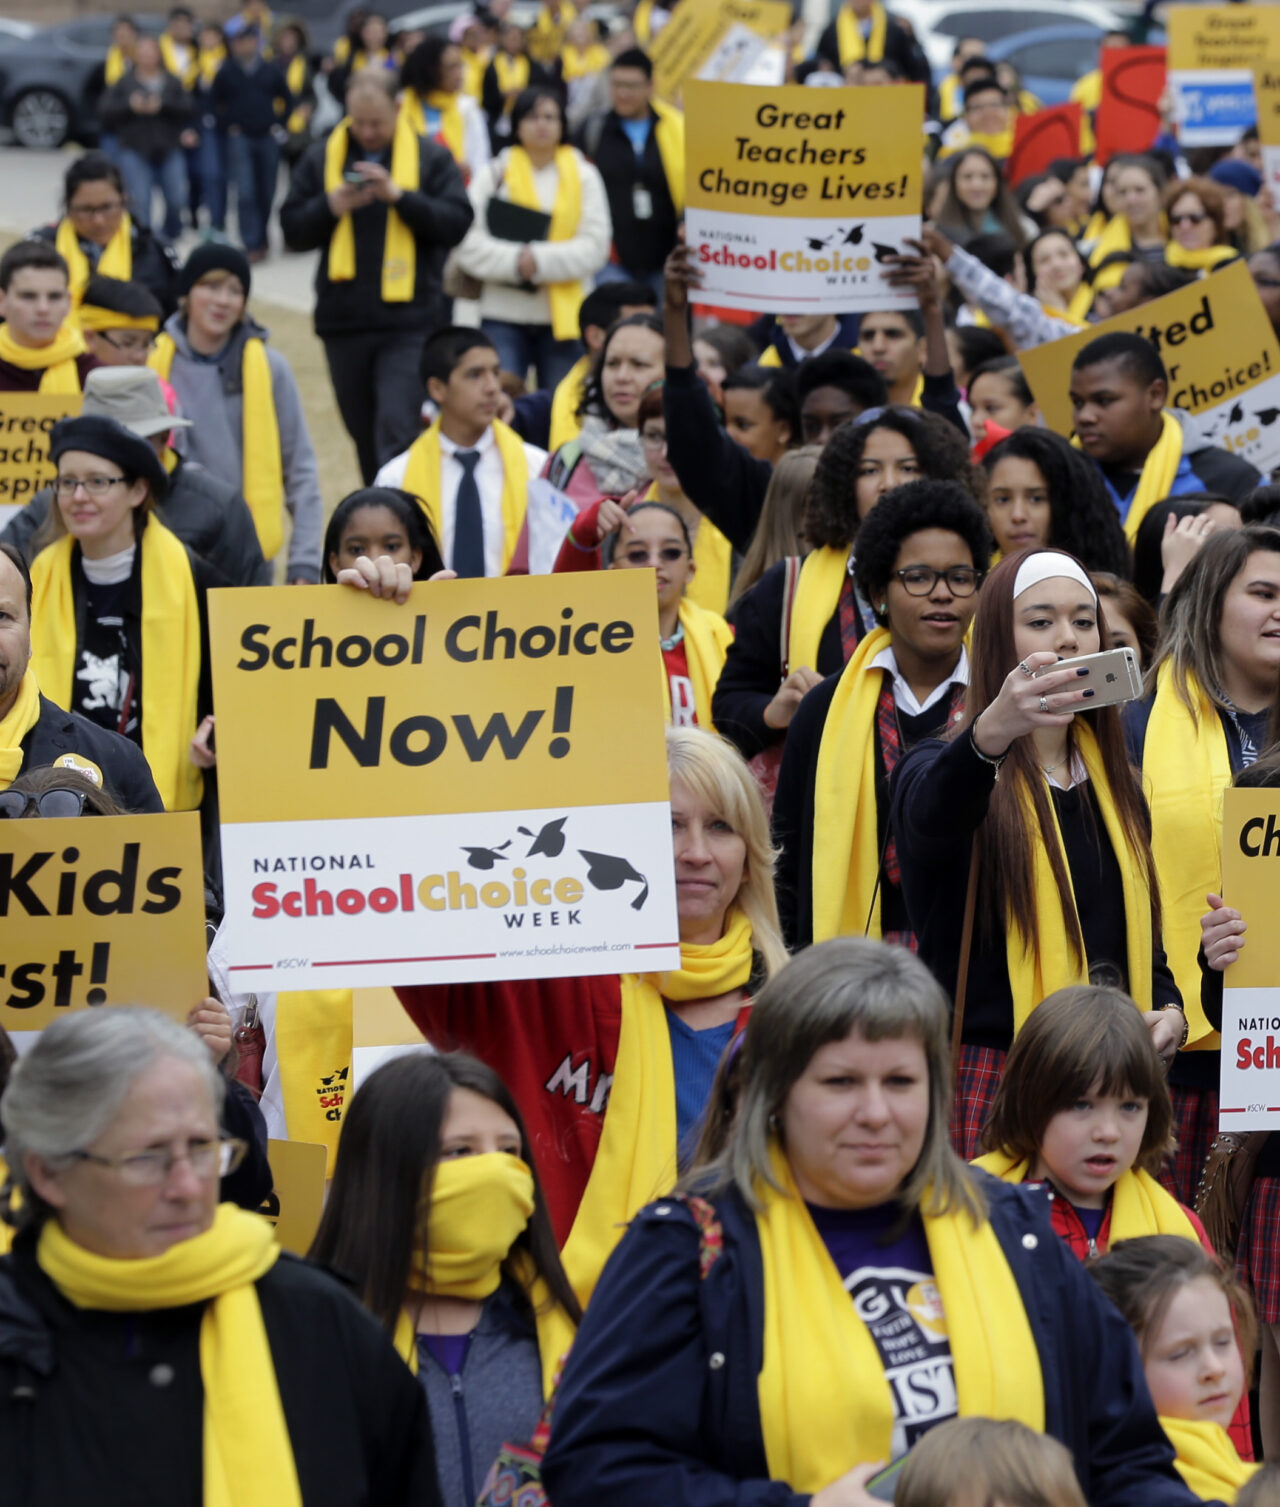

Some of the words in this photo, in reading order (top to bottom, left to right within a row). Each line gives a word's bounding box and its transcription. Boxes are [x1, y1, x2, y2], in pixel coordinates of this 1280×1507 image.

[756, 104, 846, 130] Great
[736, 137, 867, 165] Teachers
[699, 168, 808, 206] Change
[820, 174, 909, 200] Lives!
[1173, 350, 1272, 412] Choice!
[237, 614, 428, 671] School
[444, 606, 635, 663] Choice
[309, 685, 575, 770] Now!
[253, 854, 376, 874] NATIONAL
[0, 842, 183, 917] Kids
[503, 909, 582, 929] WEEK
[275, 958, 309, 970] #SCW
[499, 941, 632, 959] www.schoolchoiceweek.com
[1246, 1103, 1266, 1113] #SCW
